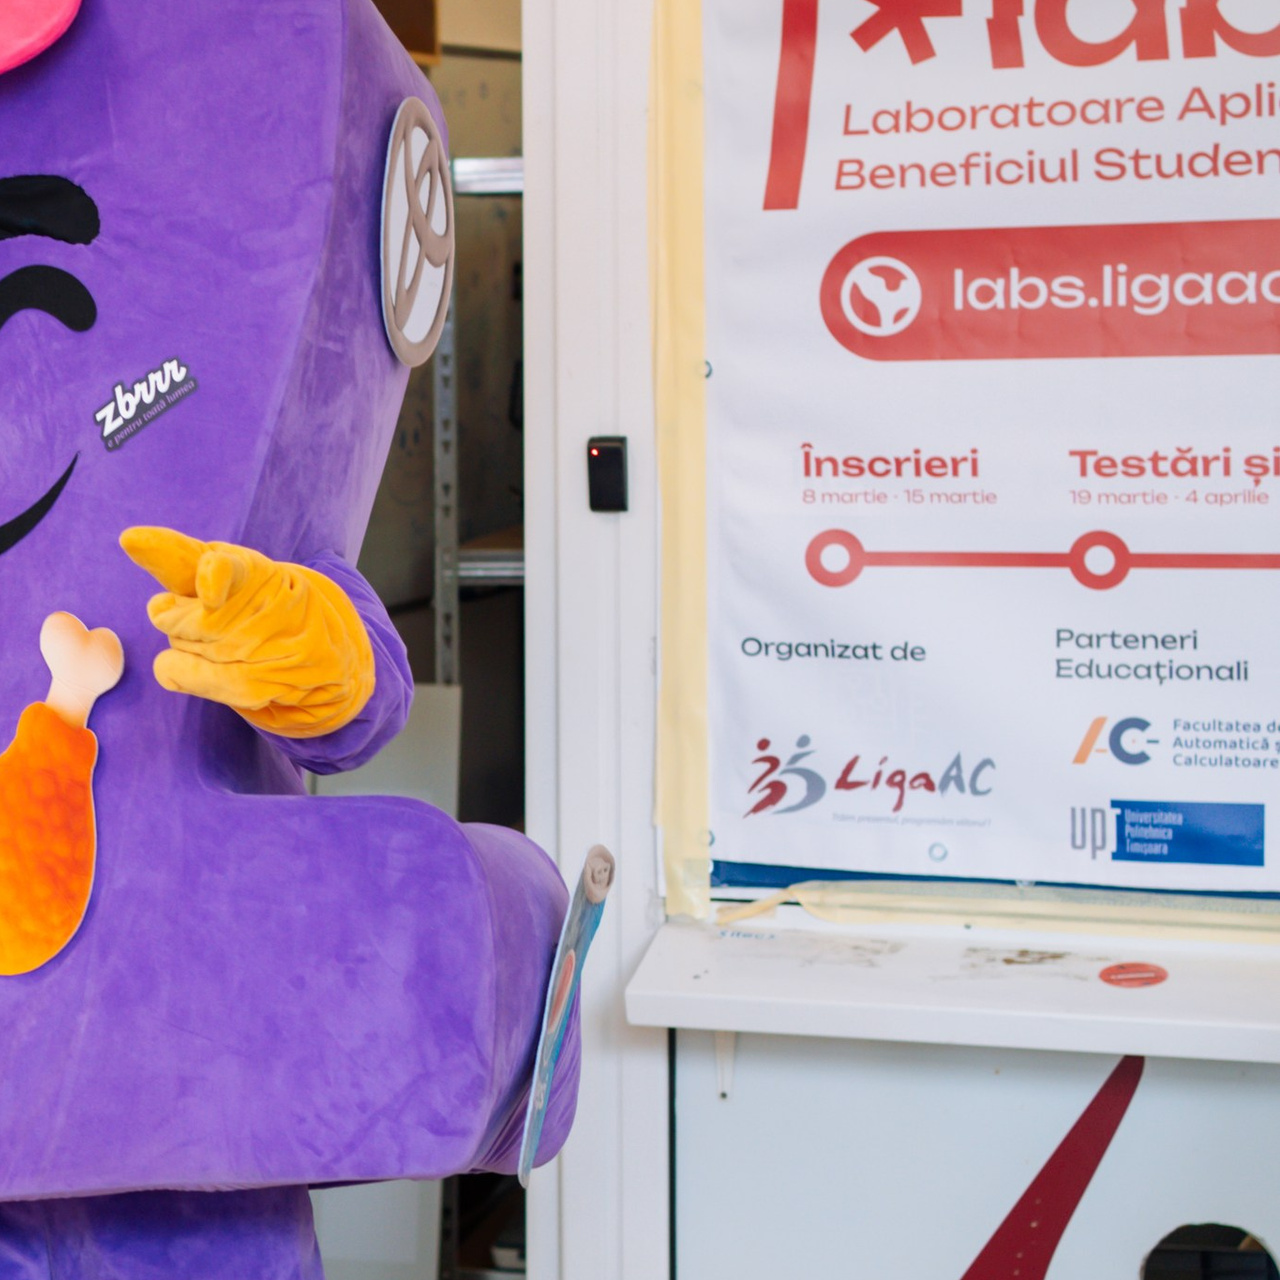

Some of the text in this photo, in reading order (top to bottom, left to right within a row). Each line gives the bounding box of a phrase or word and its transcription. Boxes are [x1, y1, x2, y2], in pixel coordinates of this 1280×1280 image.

[842, 82, 1280, 137] Laboratoare Apli
[834, 149, 1079, 191] Beneficiul
[95, 359, 187, 438] zbrrr
[114, 418, 142, 445] pentru
[166, 380, 195, 404] lumea
[801, 442, 979, 478] Înscrieri
[1068, 446, 1280, 488] Testări și
[802, 489, 997, 505] 8 martie 15 martie
[1070, 489, 1270, 507] 19 martie 4 aprilie
[741, 636, 927, 662] Organizat de
[1055, 628, 1199, 651] Parteneri
[1055, 657, 1250, 685] Educaționali
[1173, 719, 1261, 733] Facultatea
[1173, 736, 1269, 750] Automatică
[1173, 754, 1279, 769] Calculatoare
